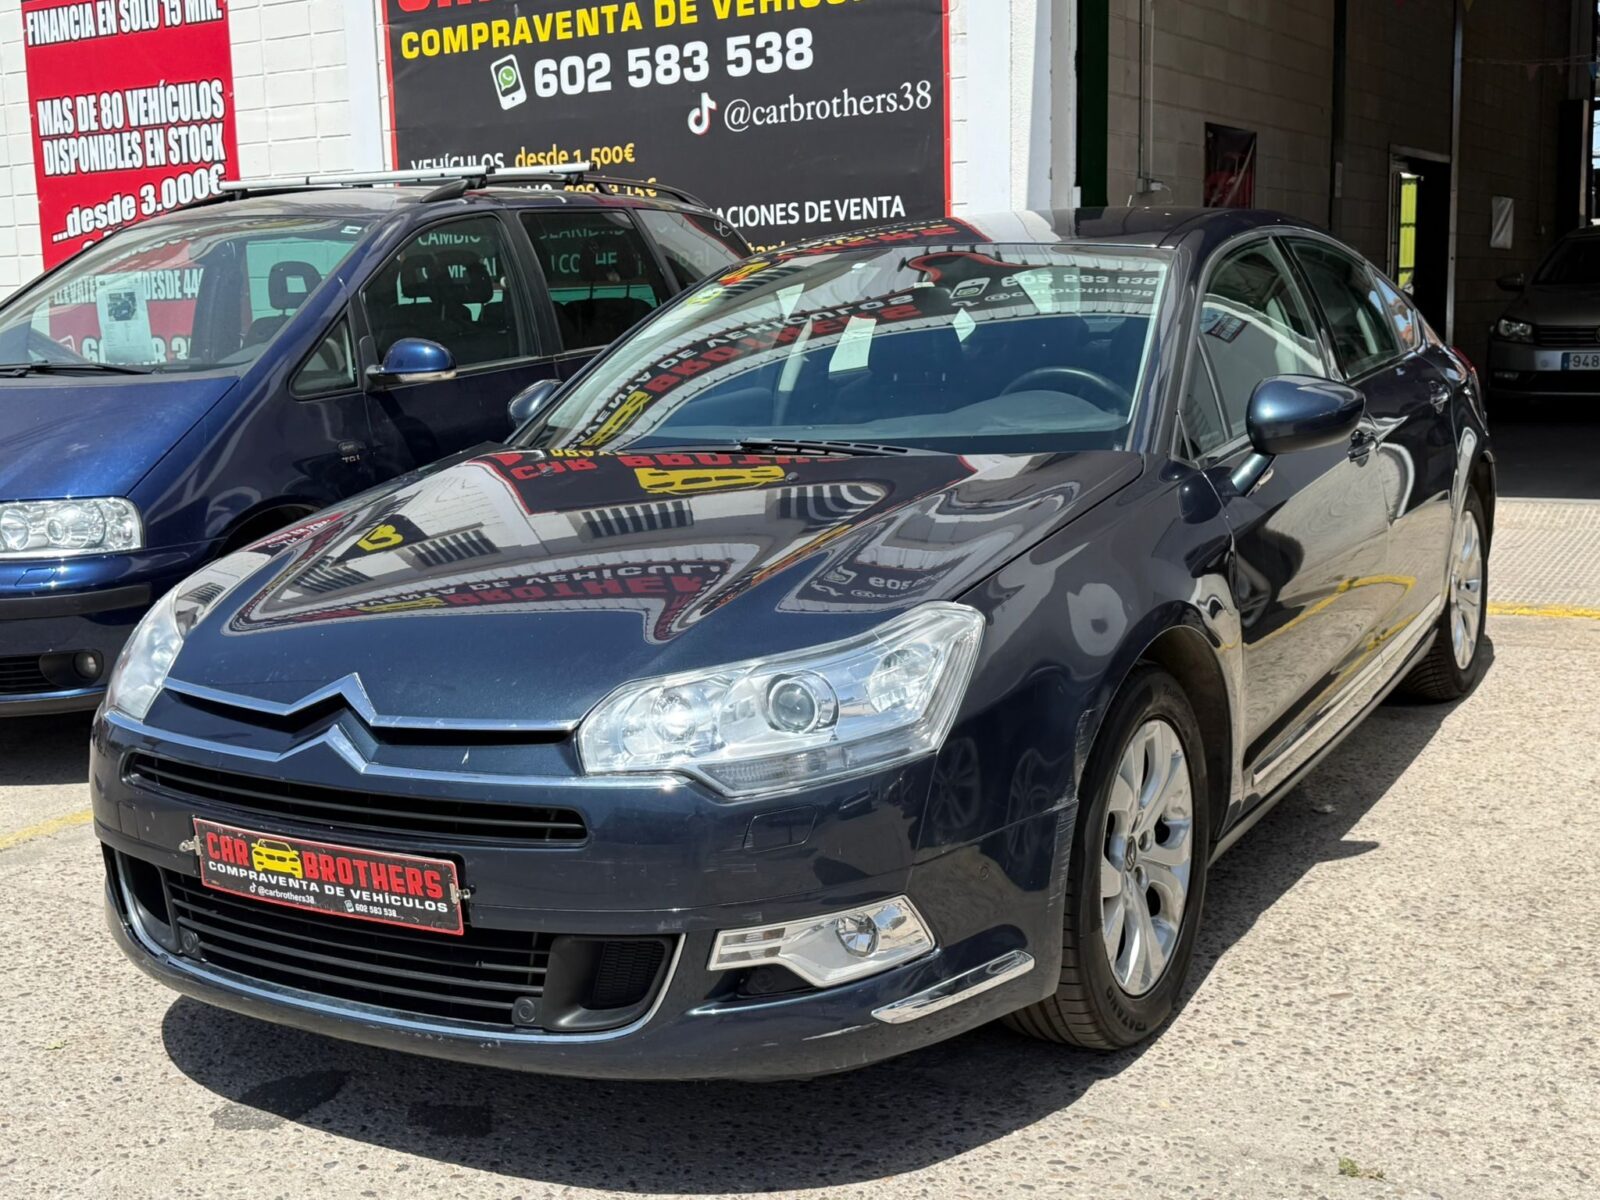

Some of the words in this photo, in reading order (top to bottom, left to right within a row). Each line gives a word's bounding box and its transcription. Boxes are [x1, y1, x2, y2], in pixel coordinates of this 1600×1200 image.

[26, 3, 96, 46] FINANCIA
[98, 1, 118, 35] EN
[119, 0, 160, 33] SOLO
[162, 0, 182, 27] 15
[401, 2, 642, 59] COMPRAVENTA
[655, 0, 698, 27] DE
[534, 53, 612, 98] 602
[627, 41, 709, 88] 583
[726, 28, 814, 77] 538
[37, 95, 74, 137] MAS
[77, 94, 99, 133] DE
[100, 90, 125, 131] 80
[126, 79, 225, 128] VEHÍCULOS
[724, 80, 932, 132] @carbrothers38
[42, 131, 144, 177] DISPONIBLES
[146, 131, 167, 168] EN
[168, 122, 226, 164] STOCK
[515, 144, 569, 167] desde
[140, 162, 226, 216] 3.000€
[710, 201, 799, 228] ACIONES
[804, 200, 832, 223] DE
[834, 195, 906, 221] VENTA
[142, 270, 182, 300] DESDE
[206, 831, 250, 867] CAR
[301, 851, 443, 899] BROTHERS
[208, 861, 319, 893] COMPRAVENTA
[324, 884, 345, 897] DE
[350, 888, 448, 912] VEHÍCULOS
